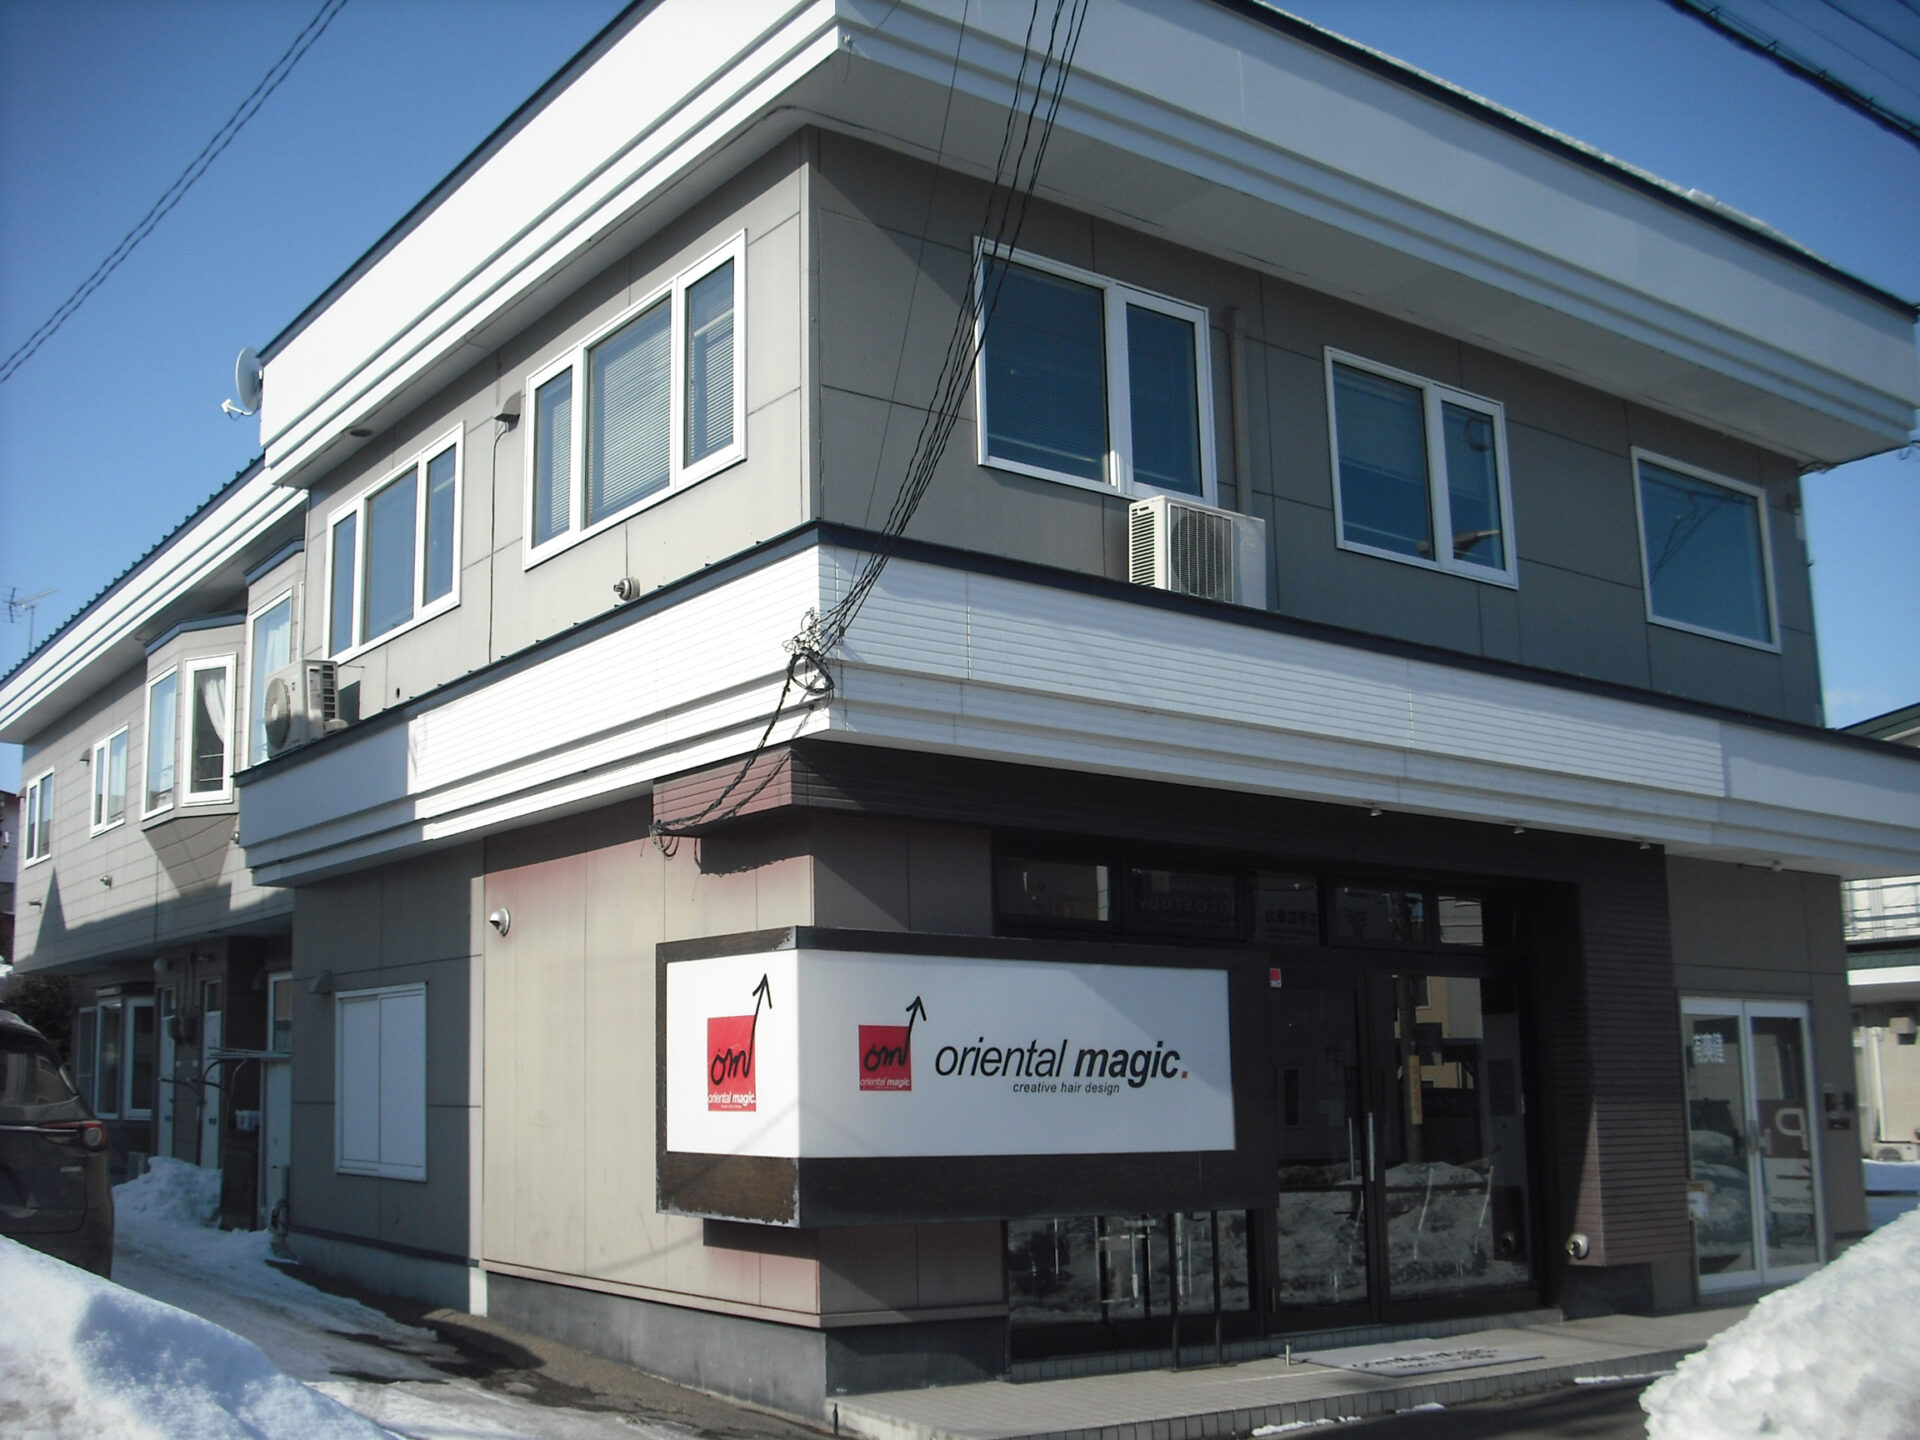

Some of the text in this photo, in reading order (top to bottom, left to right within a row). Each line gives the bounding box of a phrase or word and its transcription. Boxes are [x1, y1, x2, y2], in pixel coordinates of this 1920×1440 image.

[935, 1037, 1188, 1088] oriental magic.
[1013, 1082, 1120, 1096] creative hair design
[708, 1091, 731, 1104] oriental
